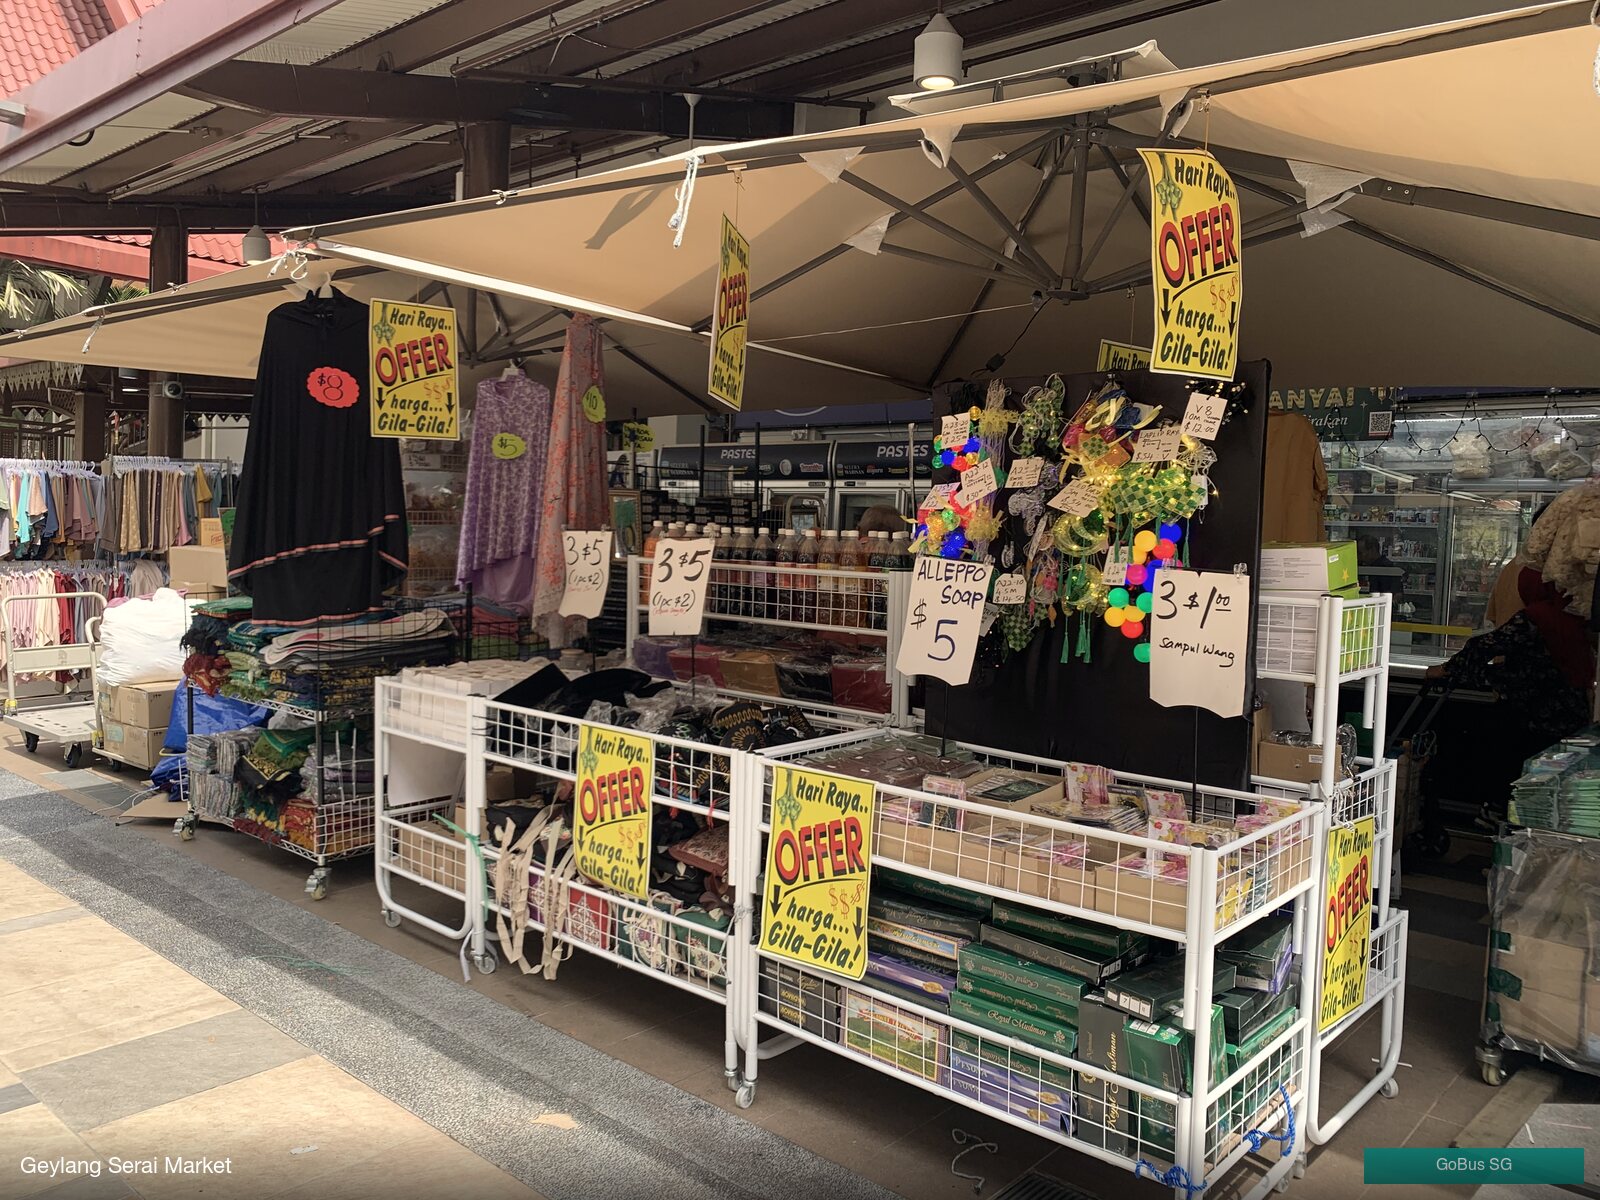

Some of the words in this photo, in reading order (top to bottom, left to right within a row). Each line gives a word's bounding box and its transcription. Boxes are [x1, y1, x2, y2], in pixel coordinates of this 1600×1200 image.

[1174, 157, 1204, 188] Hari
[1159, 202, 1238, 288] OFFER
[390, 307, 415, 327] Hari
[718, 272, 747, 331] OFFER
[375, 333, 454, 387] OFFER
[1160, 331, 1233, 370] Gila-Gila!
[317, 372, 344, 401] $8
[377, 412, 453, 434] Gila-Gila!
[498, 436, 518, 457] $5
[877, 445, 929, 458] PASTES
[566, 536, 580, 566] 3
[582, 538, 604, 566] $5
[657, 547, 674, 582] 3
[678, 549, 711, 582] $5
[917, 559, 987, 583] ALLEPPO
[940, 585, 984, 610] Soap
[1156, 580, 1178, 620] 3
[927, 619, 959, 661] 5
[1159, 637, 1200, 657] Sampul
[1203, 644, 1235, 668] Wang
[594, 733, 617, 756] Hari
[580, 766, 648, 826] OFFER
[796, 775, 825, 803] Hari
[775, 816, 866, 885] OFFER
[1338, 833, 1352, 859] Hari
[580, 856, 643, 893] Gila-Gila!
[1327, 854, 1369, 954] OFFER
[768, 921, 861, 970] Gila-Gila!
